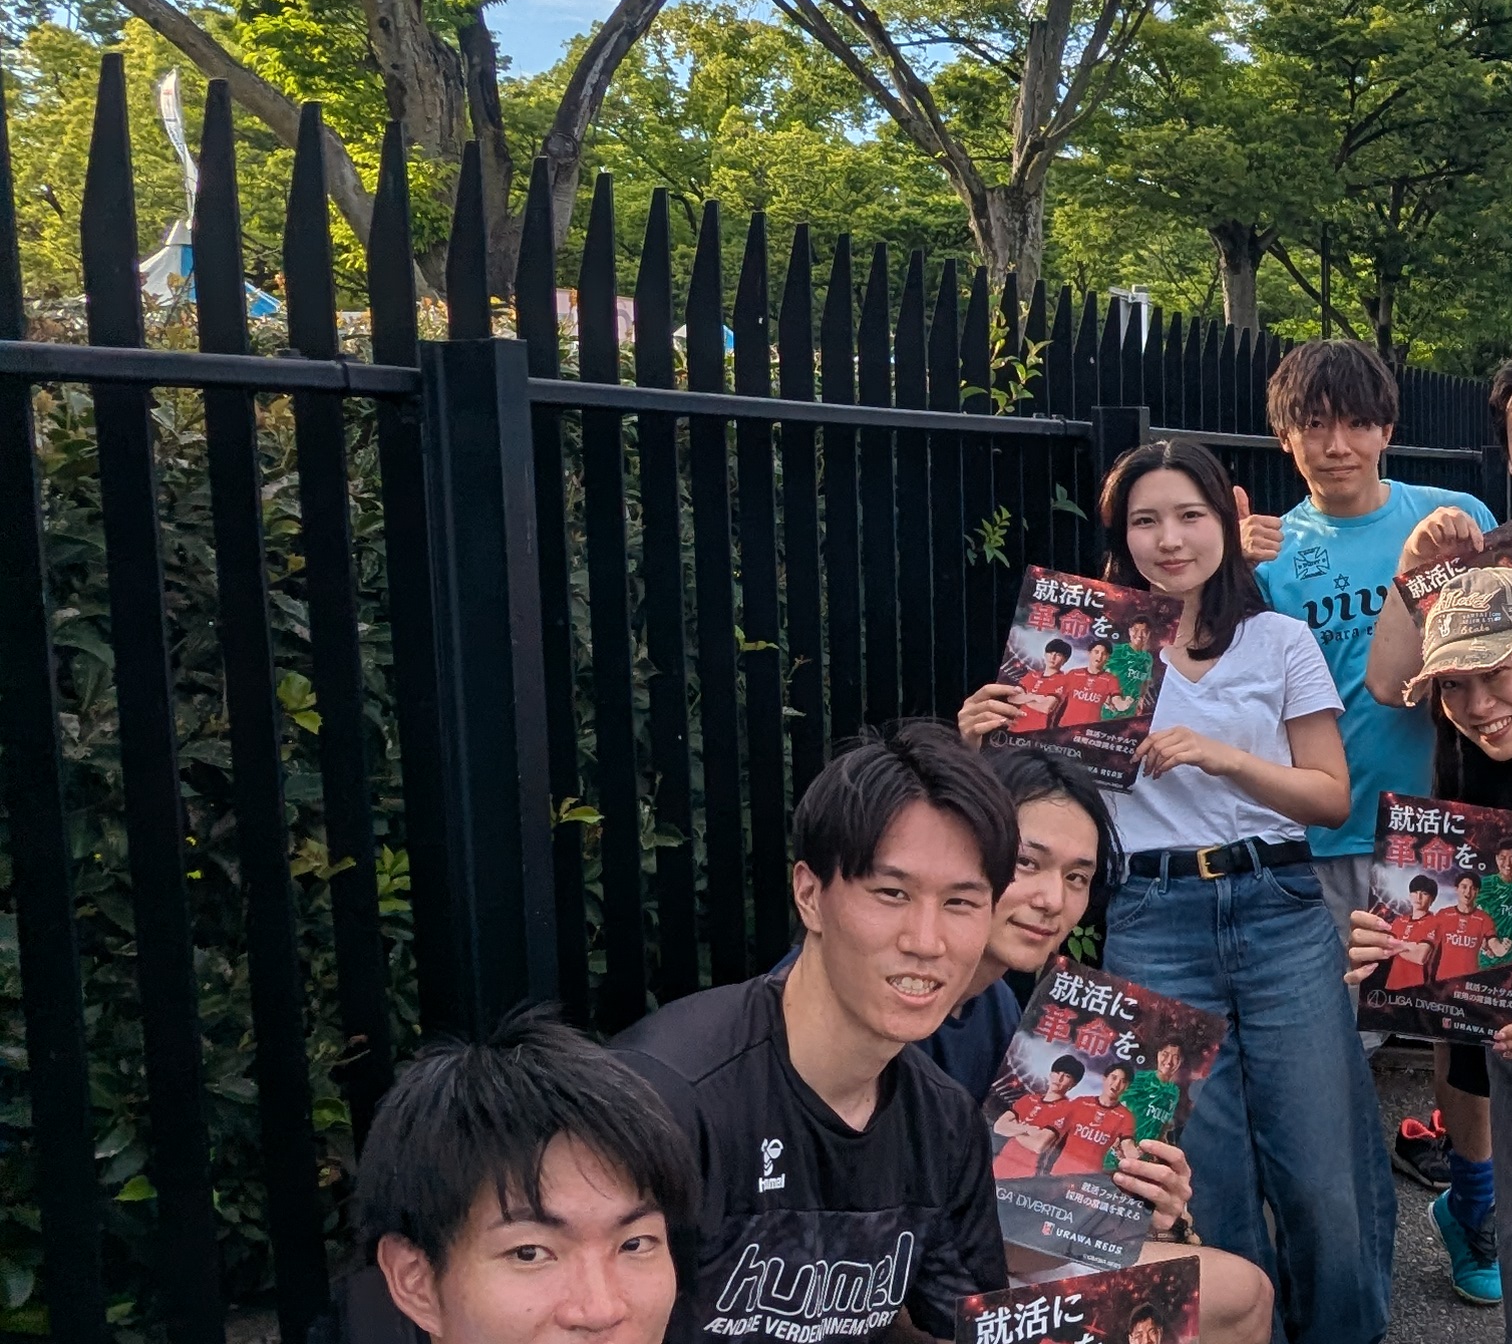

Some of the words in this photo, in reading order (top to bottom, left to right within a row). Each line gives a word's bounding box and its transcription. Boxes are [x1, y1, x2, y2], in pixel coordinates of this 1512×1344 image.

[1033, 578, 1106, 609] 就活に
[1405, 557, 1467, 599] 就活に
[1027, 602, 1120, 640] 革命を。
[1072, 689, 1101, 703] POLUS
[1387, 804, 1465, 835] 就活に
[1384, 834, 1486, 872] 革命を。
[1446, 933, 1478, 949] POLUS
[1049, 971, 1139, 1021] 就活に
[1033, 1004, 1146, 1065] 革命を。
[1073, 1123, 1112, 1146] POLUS
[1056, 1227, 1092, 1247] URAWA
[1094, 1239, 1124, 1255] REDS
